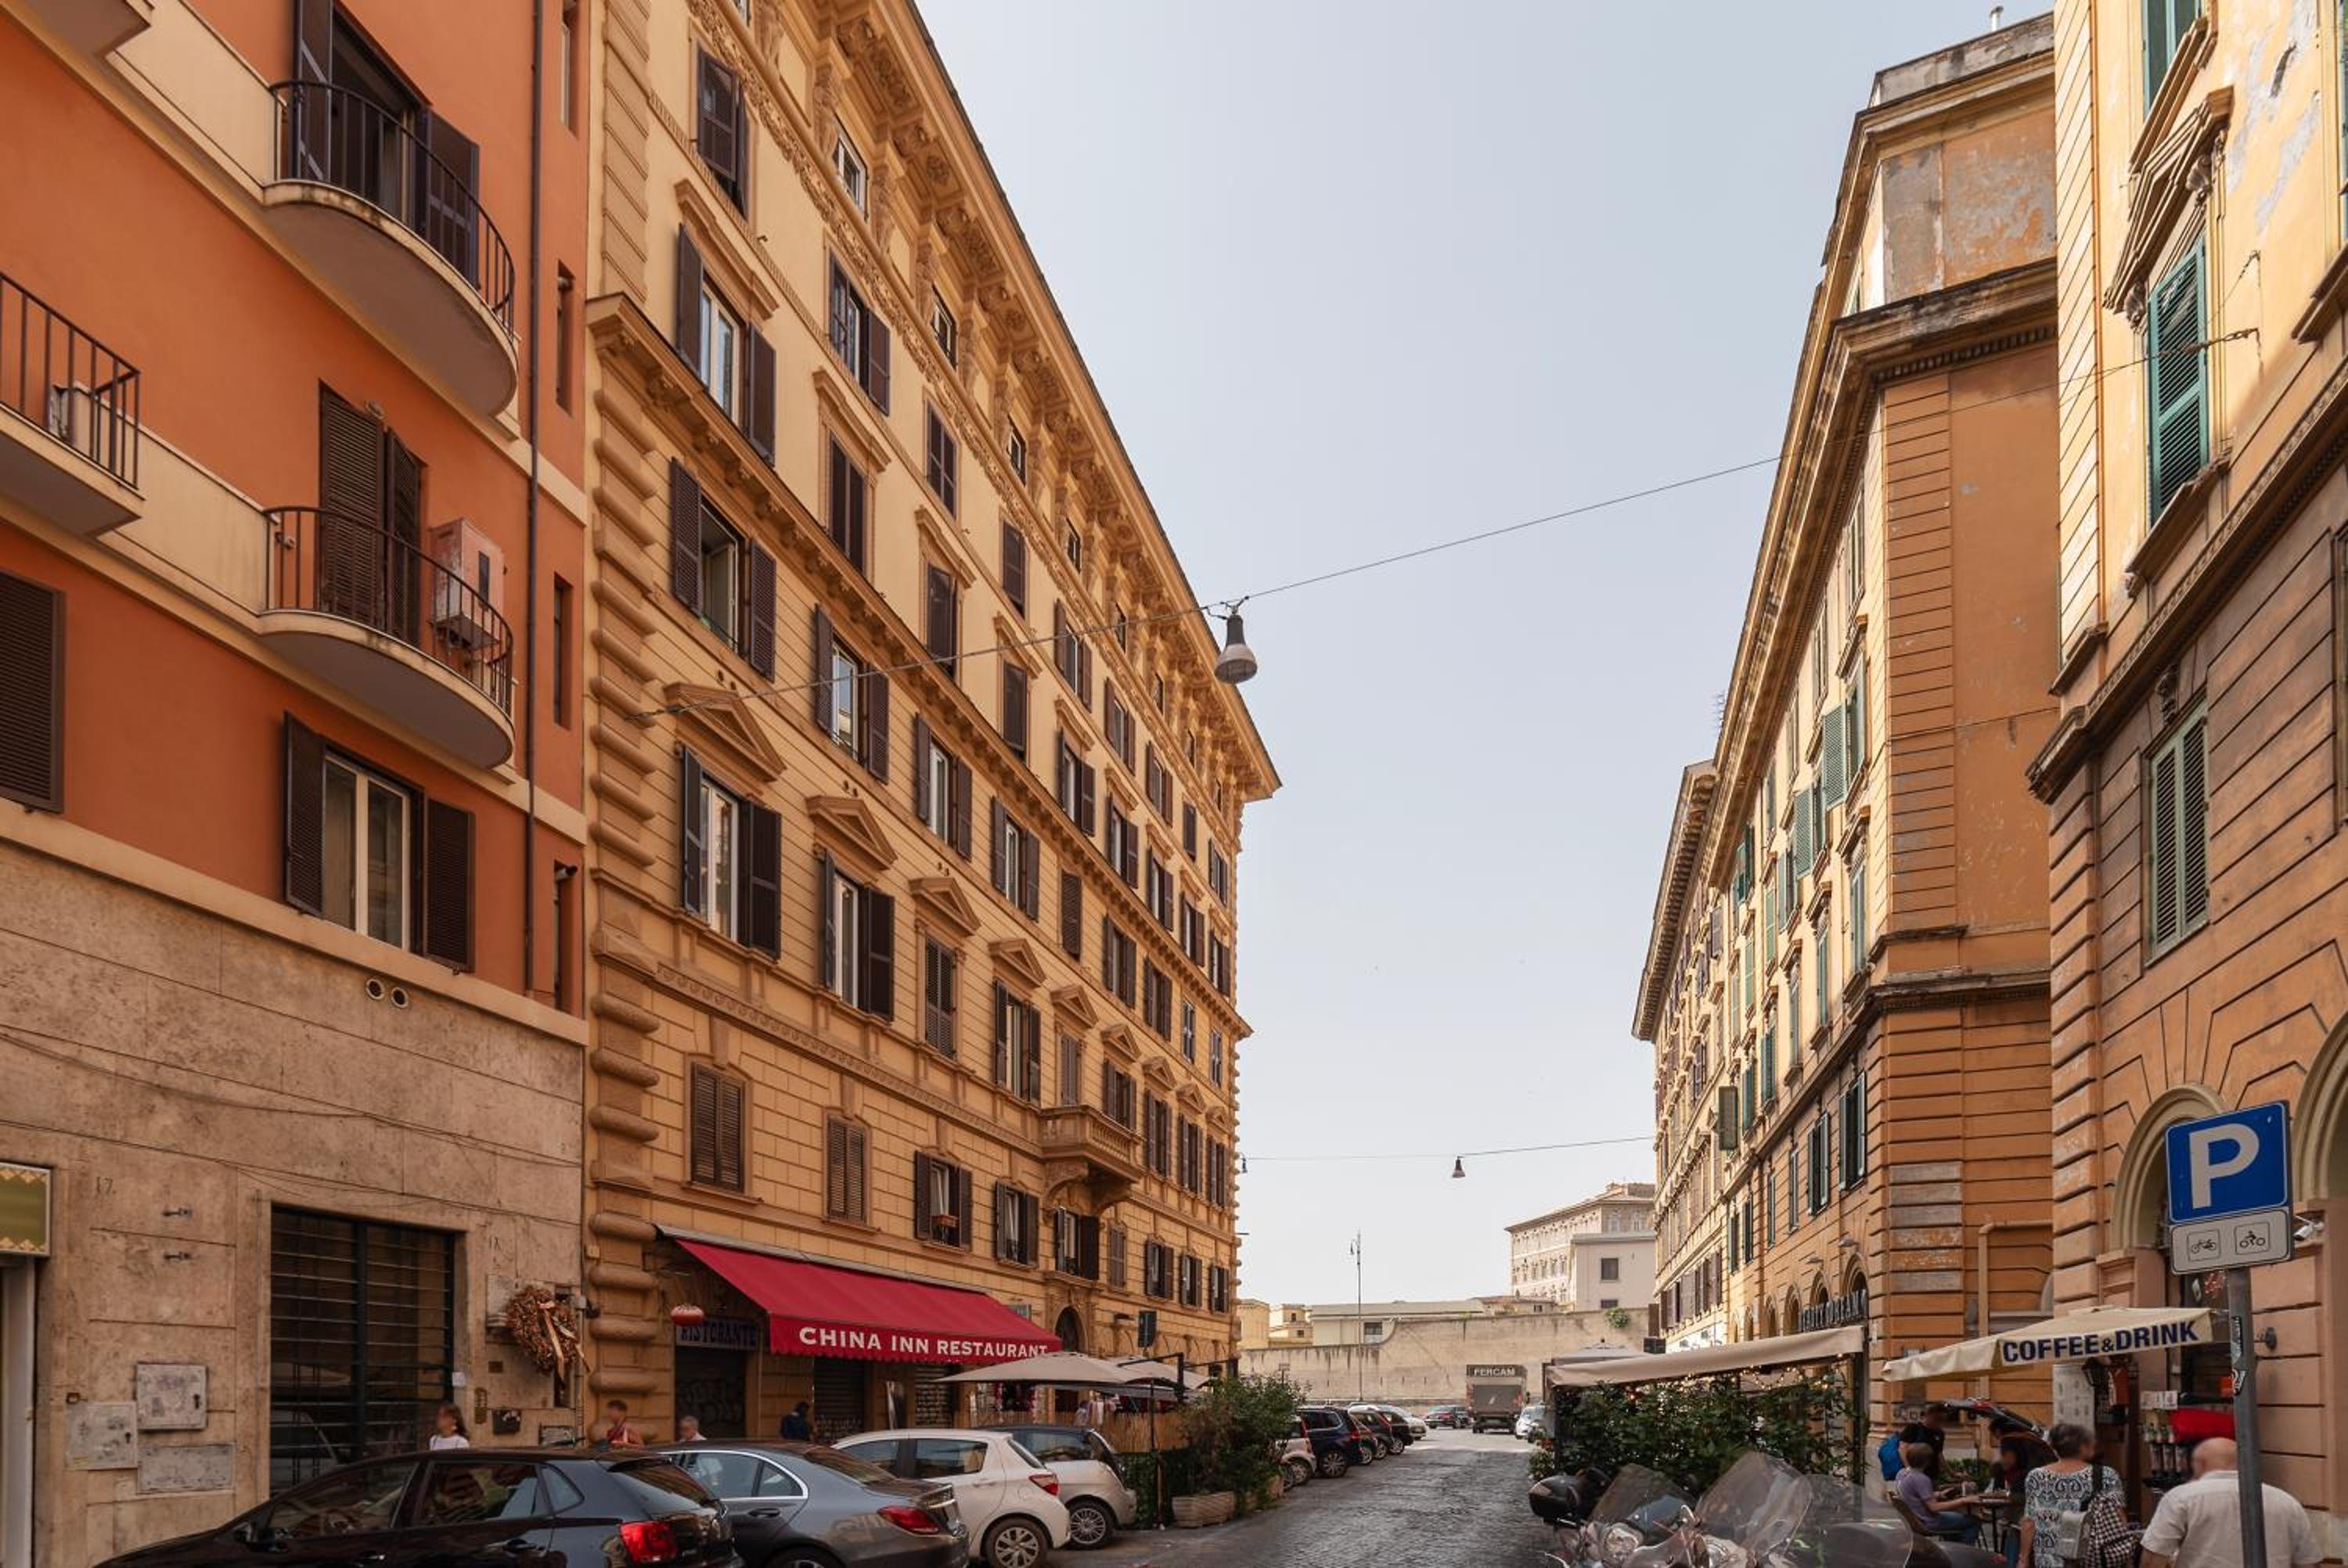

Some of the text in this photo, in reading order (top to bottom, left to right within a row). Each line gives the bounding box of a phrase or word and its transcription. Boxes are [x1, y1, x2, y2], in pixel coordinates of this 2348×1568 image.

[2189, 1124, 2260, 1209] P
[799, 1327, 1048, 1358] CHINA INN RESTAURANT
